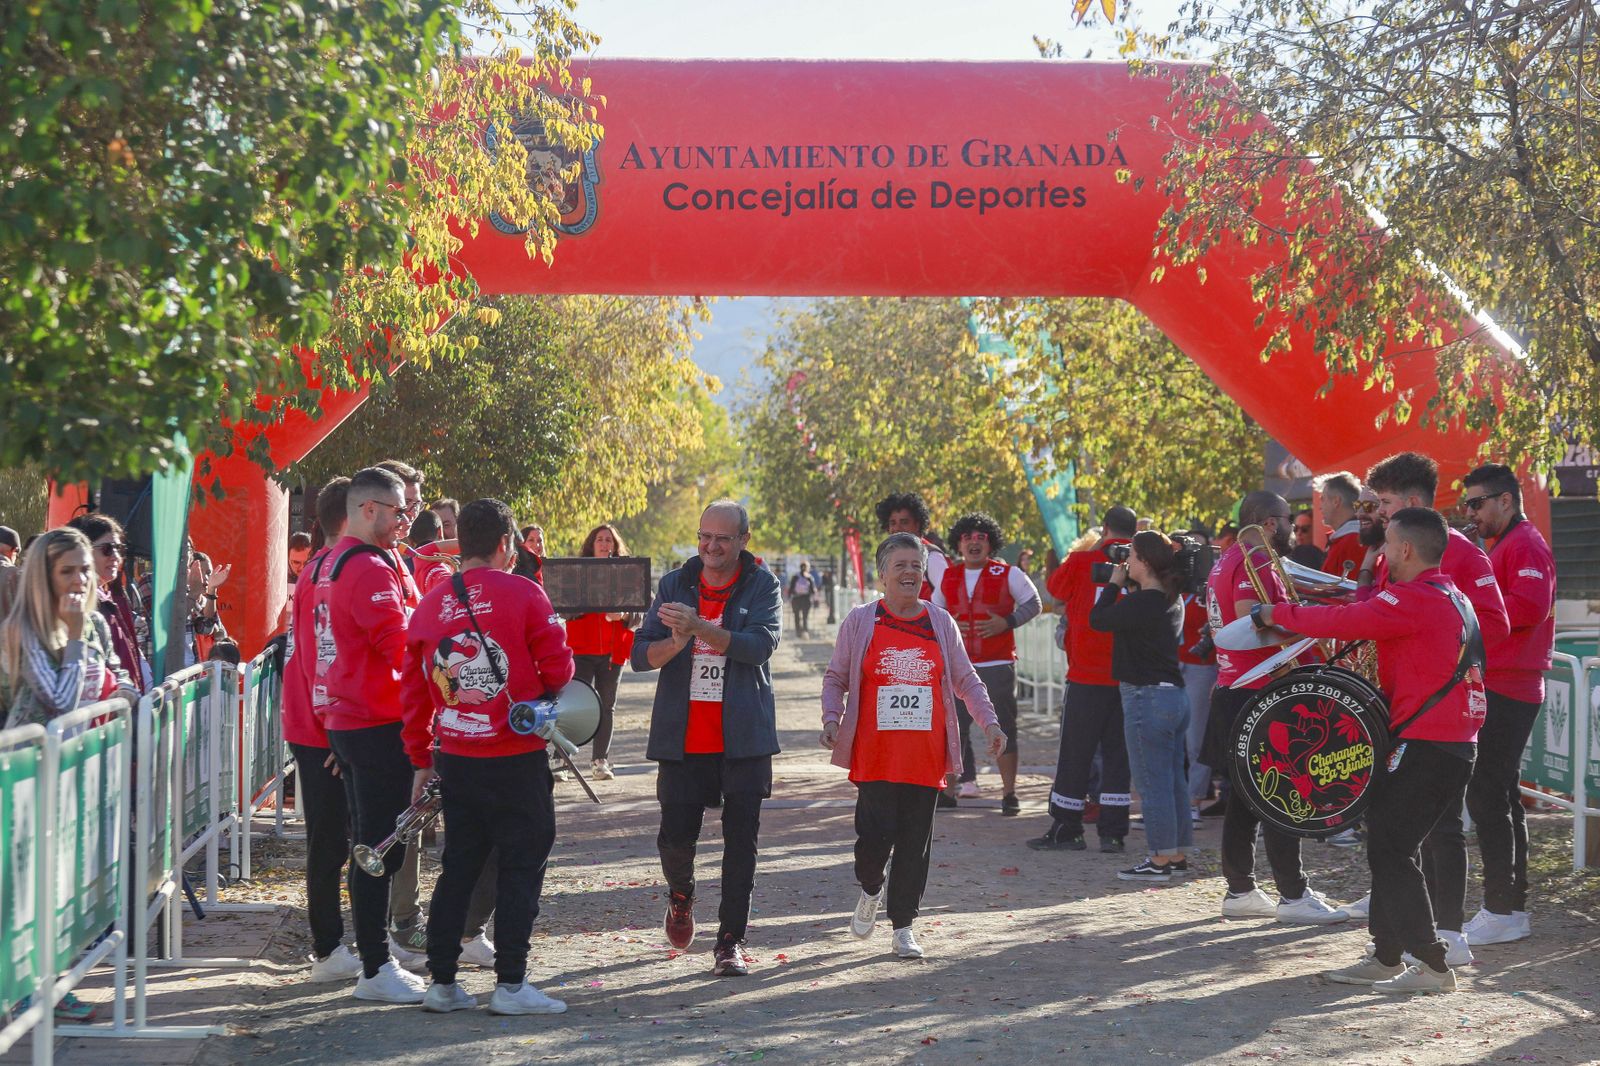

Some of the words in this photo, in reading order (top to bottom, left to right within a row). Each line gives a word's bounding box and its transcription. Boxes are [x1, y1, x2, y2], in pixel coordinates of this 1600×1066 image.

[620, 140, 894, 170] AYUNTAMIENTO
[907, 143, 949, 168] DE
[961, 137, 1128, 168] GRANADA
[663, 178, 858, 216] Concejalía
[871, 180, 917, 210] de
[931, 178, 1087, 214] Deportes
[881, 656, 931, 673] carrera
[890, 695, 920, 709] 202
[1237, 735, 1248, 758] 685
[1243, 711, 1260, 732] 394
[1258, 692, 1281, 711] 564
[1291, 683, 1314, 694] 639
[1317, 684, 1341, 699] 200
[1342, 695, 1364, 714] 877
[1308, 743, 1373, 776] Charanga
[1319, 765, 1337, 785] La
[1336, 754, 1374, 781] Yunka
